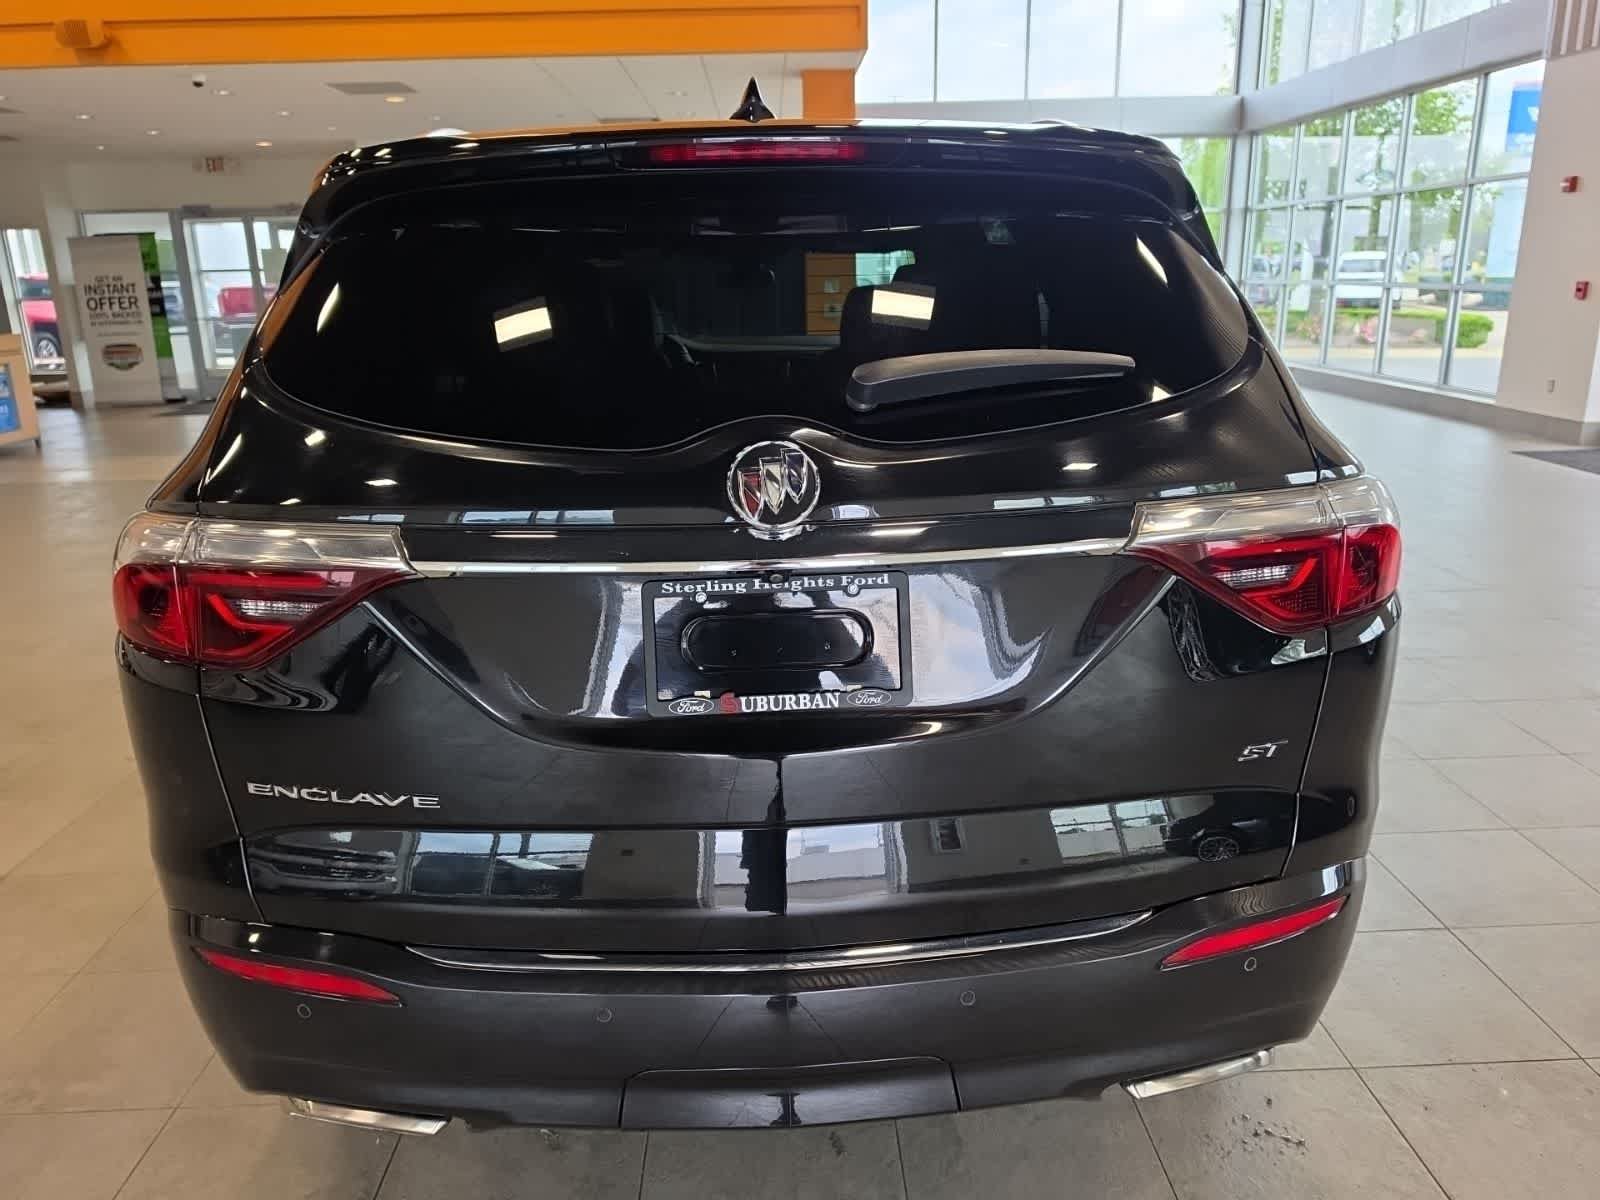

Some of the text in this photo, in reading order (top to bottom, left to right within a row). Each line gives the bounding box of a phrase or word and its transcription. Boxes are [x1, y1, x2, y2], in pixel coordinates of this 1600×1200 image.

[84, 283, 136, 296] INSTANT
[86, 297, 139, 311] OFFER
[661, 580, 747, 594] Sterling
[841, 573, 890, 587] Ford
[719, 691, 841, 714] SUBURBAN
[1237, 739, 1289, 762] ST
[247, 781, 441, 809] ENCLAVE
